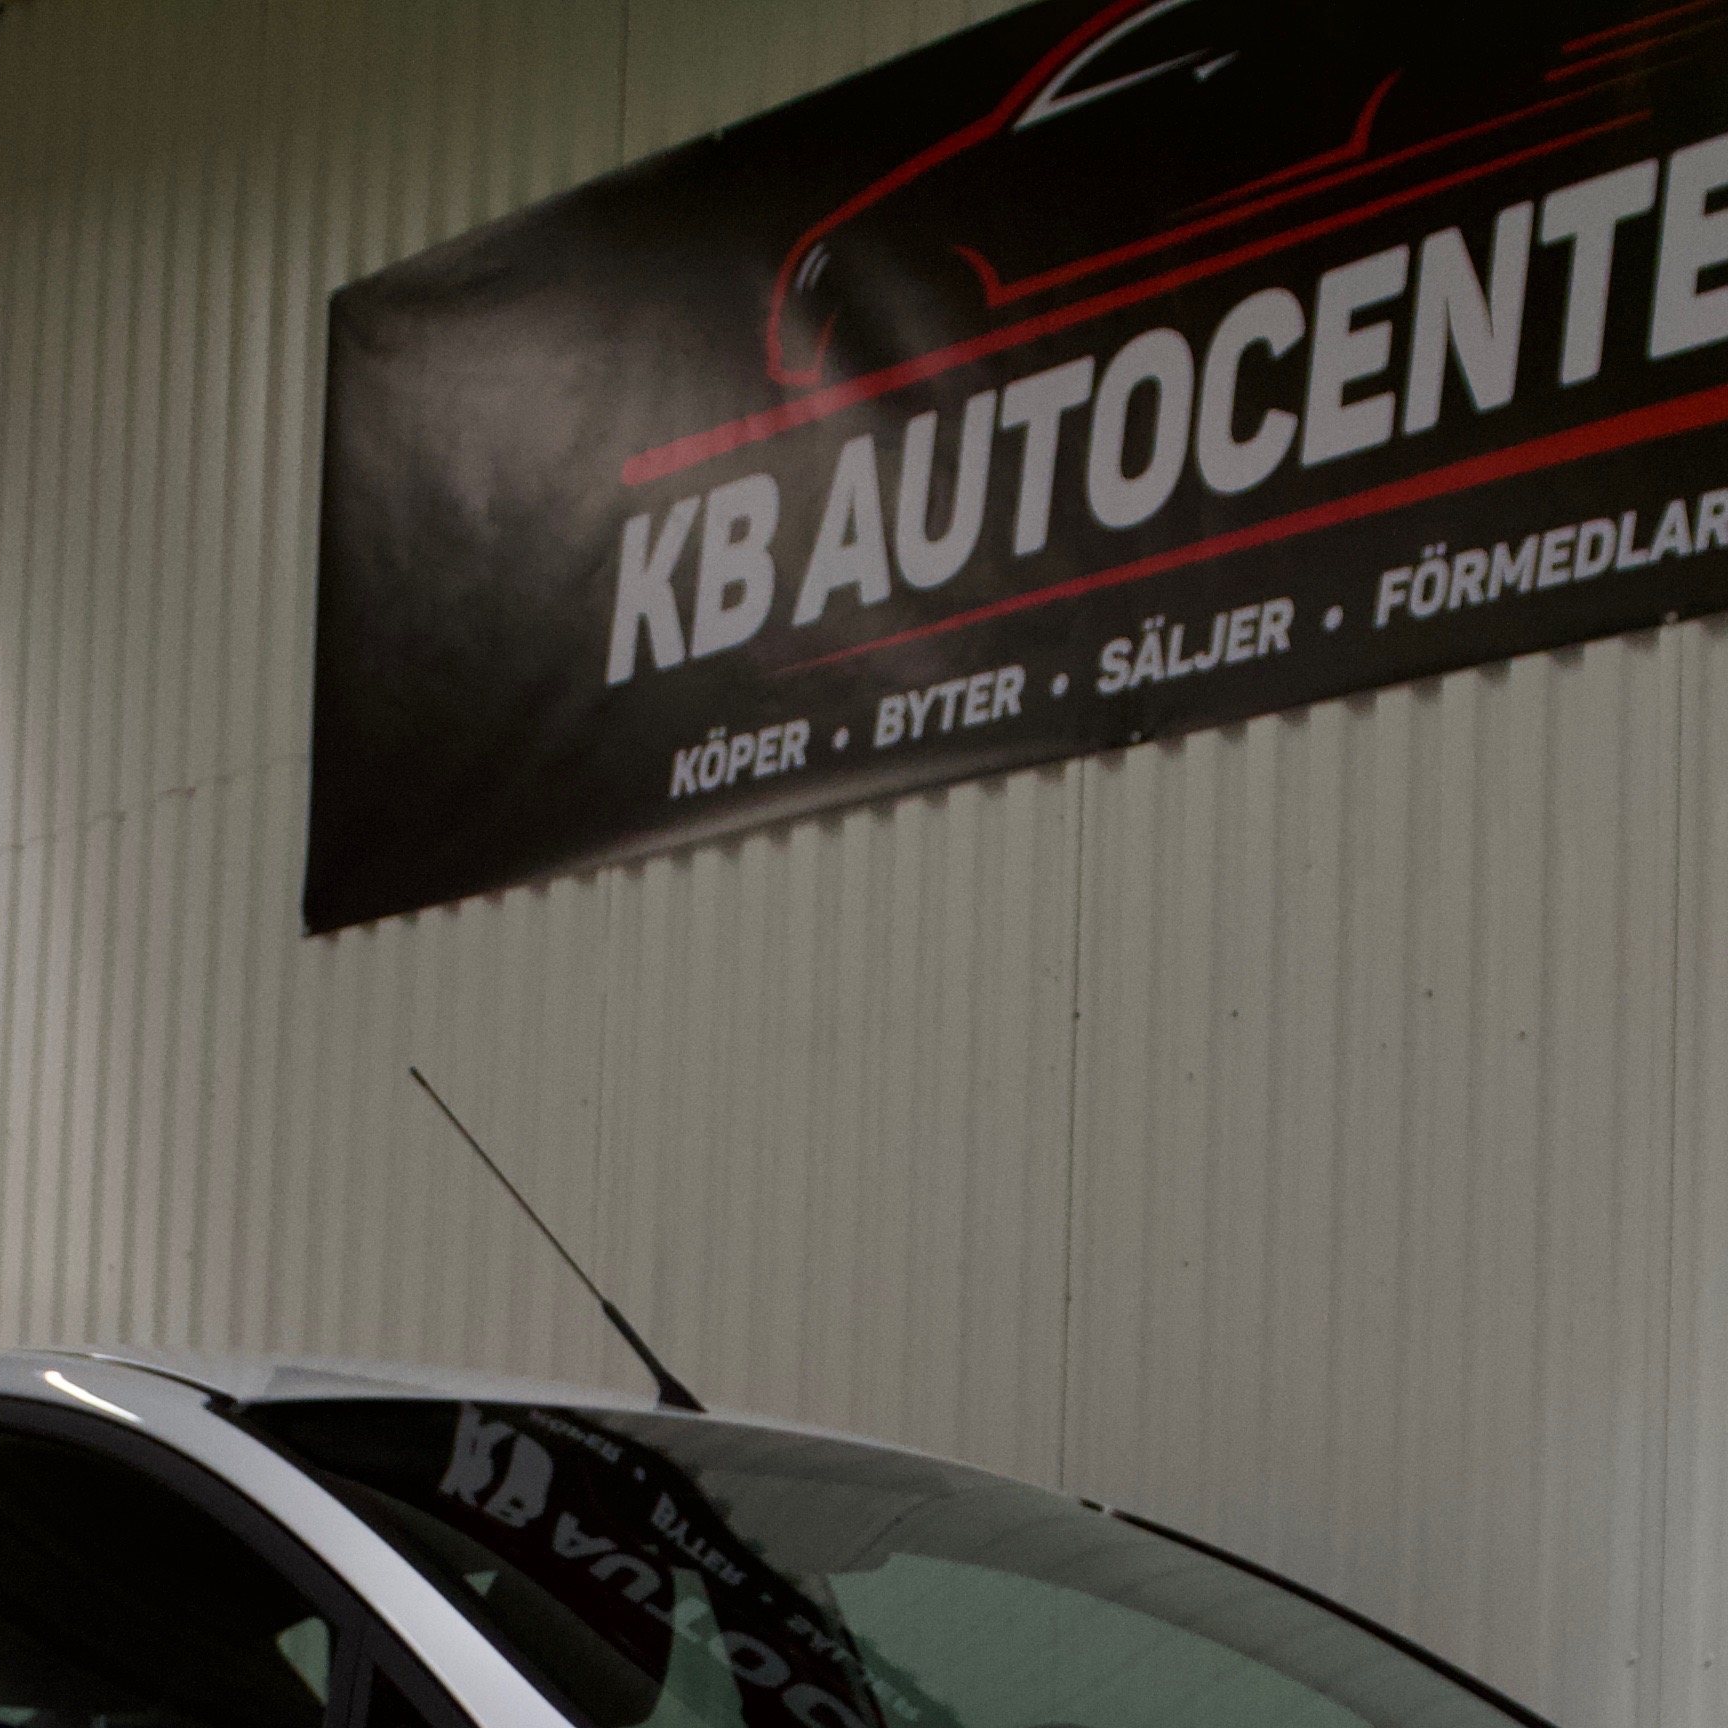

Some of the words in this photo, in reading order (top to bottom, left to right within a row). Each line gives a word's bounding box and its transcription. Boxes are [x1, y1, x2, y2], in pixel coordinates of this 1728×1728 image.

[605, 473, 780, 686] KB
[668, 718, 812, 799] KÖPER
[874, 664, 1027, 747] BYTER
[1096, 597, 1296, 693] SÄLJER
